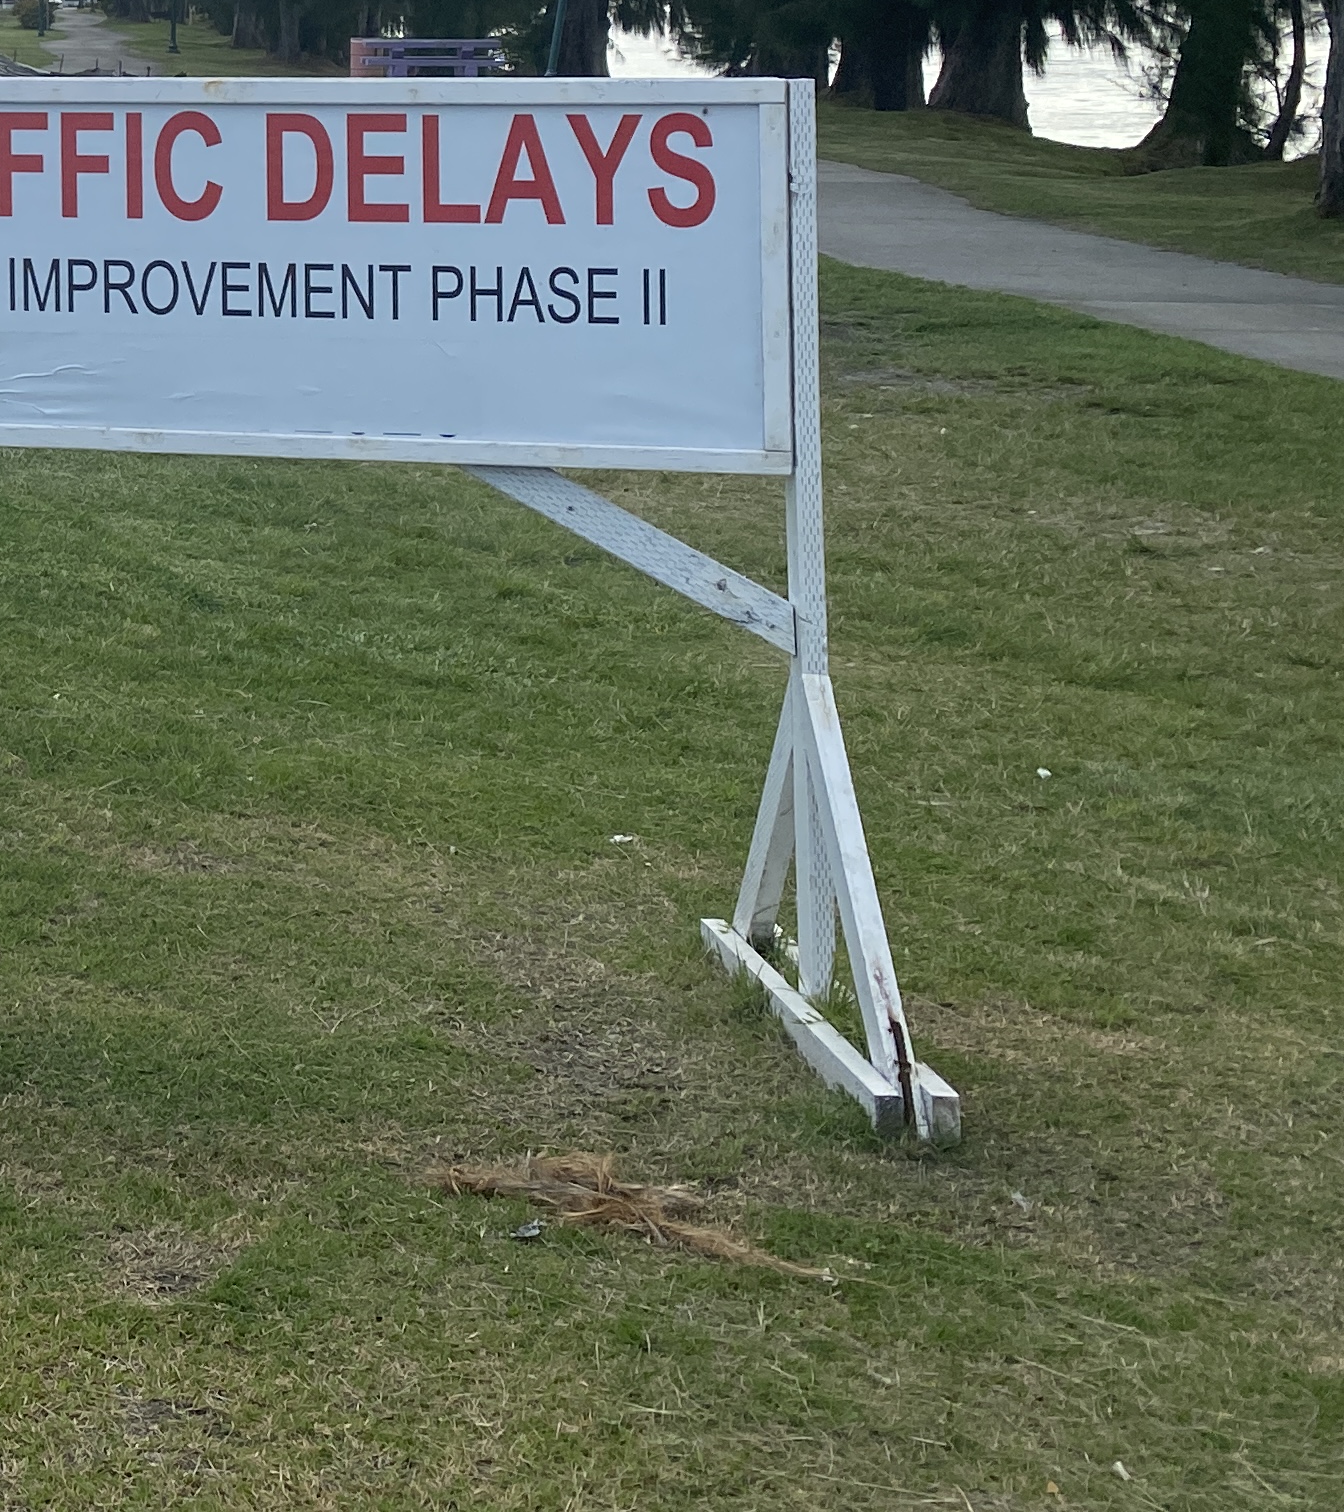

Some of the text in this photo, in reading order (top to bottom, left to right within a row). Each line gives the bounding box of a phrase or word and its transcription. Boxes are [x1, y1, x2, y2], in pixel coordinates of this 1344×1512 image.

[266, 112, 715, 228] DELAYS
[8, 257, 412, 321] IMPROVEMENT
[431, 265, 620, 325] PHASE
[643, 268, 667, 326] II
